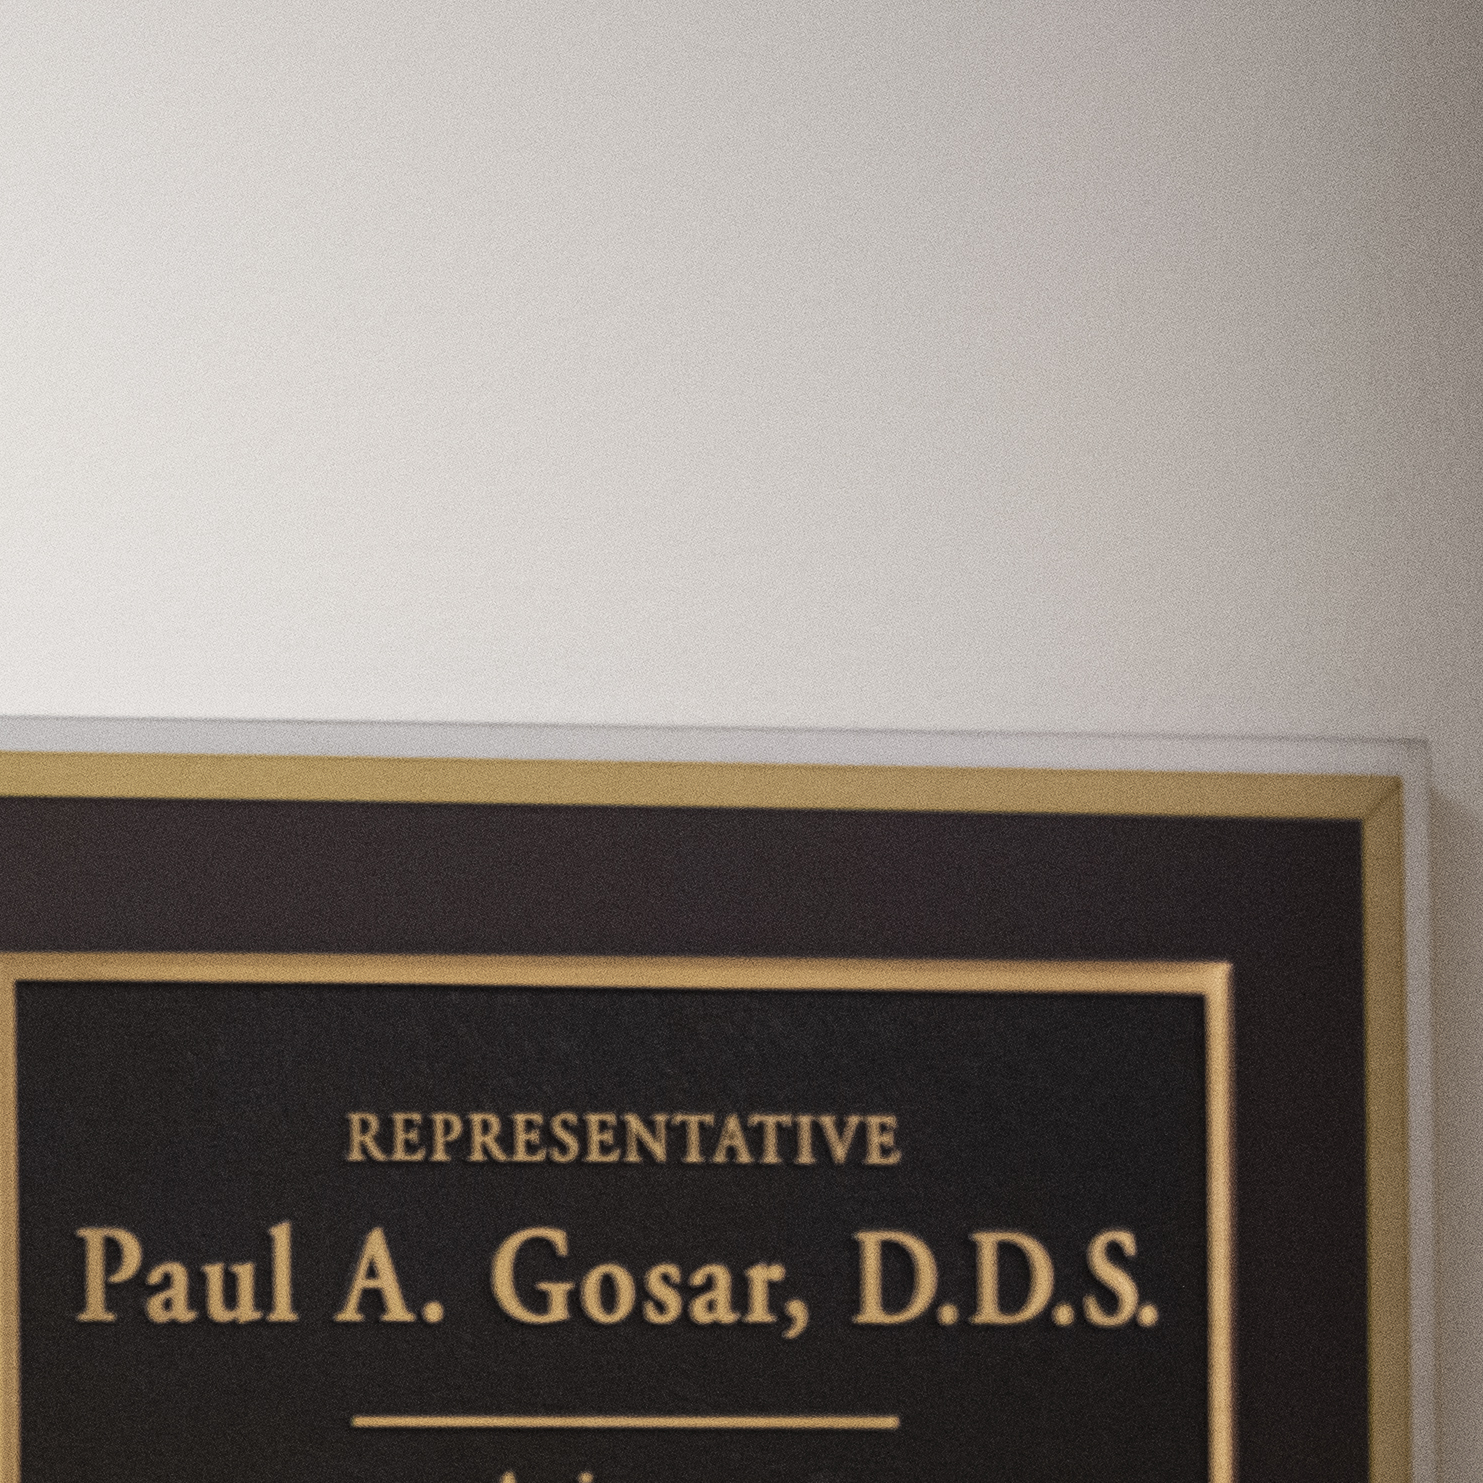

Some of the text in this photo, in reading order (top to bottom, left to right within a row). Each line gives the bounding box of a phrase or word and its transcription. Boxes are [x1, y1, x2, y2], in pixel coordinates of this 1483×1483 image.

[347, 1111, 902, 1165] REPRESENTATIVE
[77, 1221, 1159, 1338] Paul A. Gosar, D.D.S.
